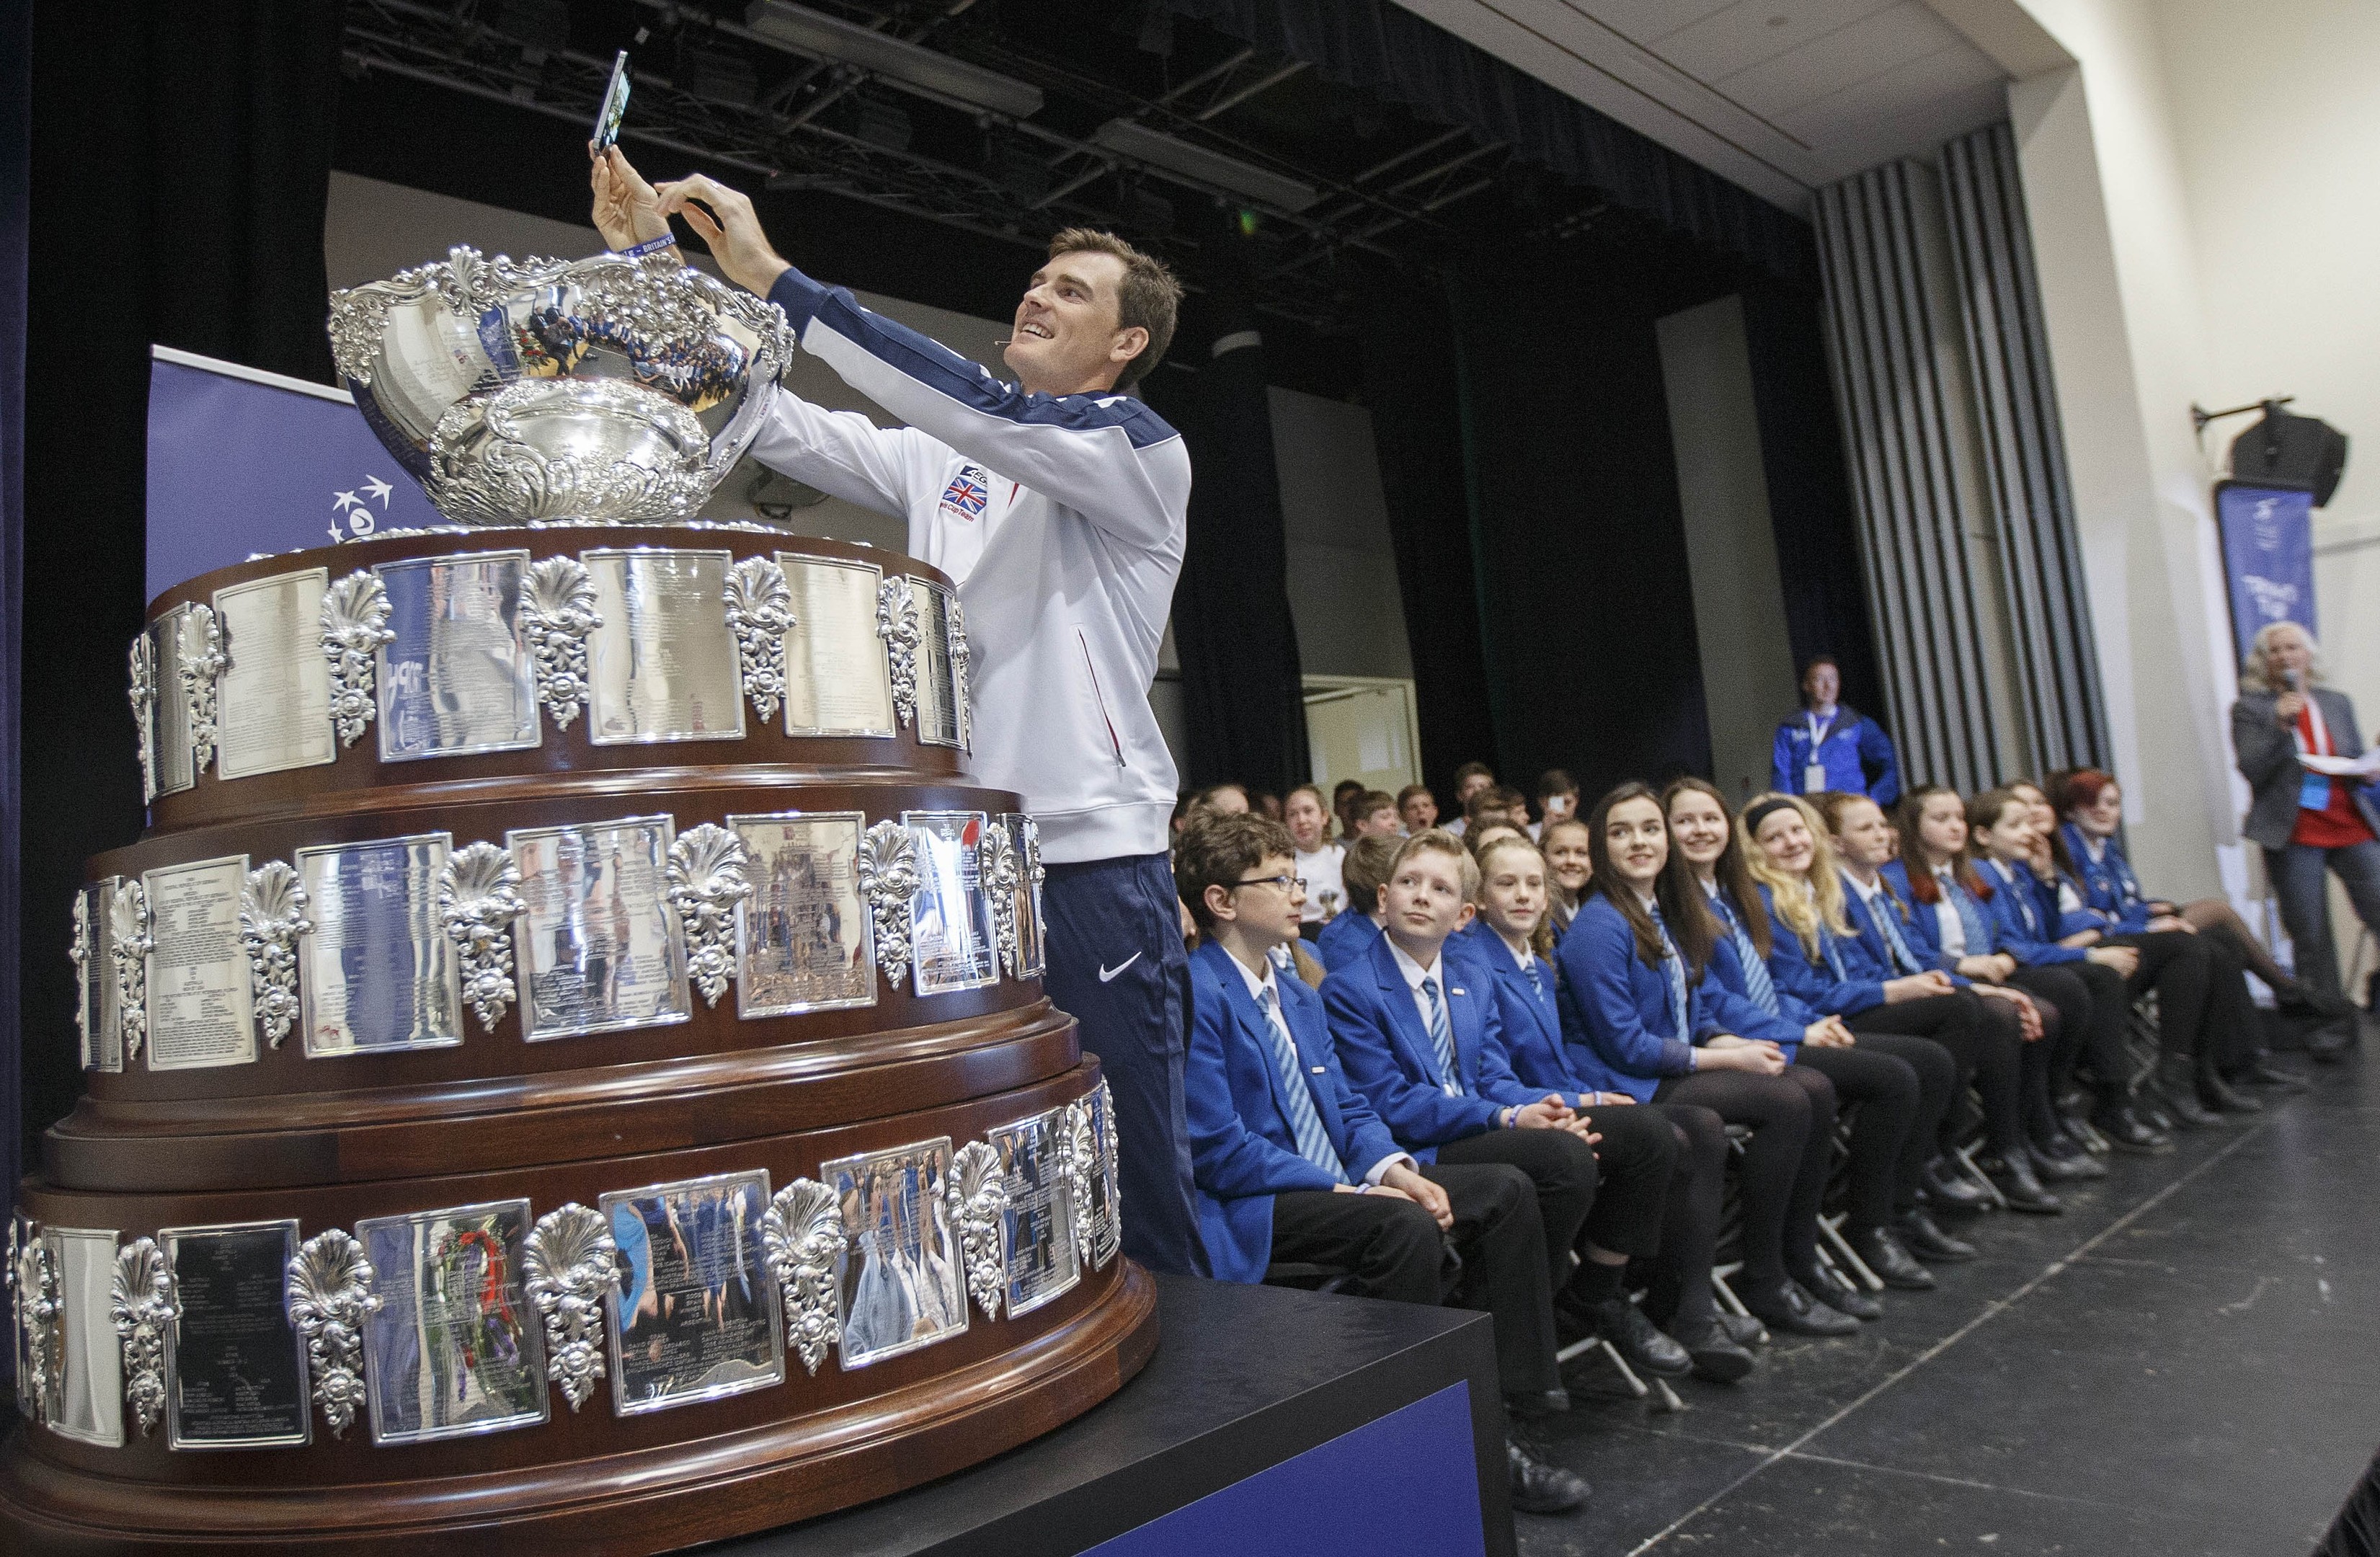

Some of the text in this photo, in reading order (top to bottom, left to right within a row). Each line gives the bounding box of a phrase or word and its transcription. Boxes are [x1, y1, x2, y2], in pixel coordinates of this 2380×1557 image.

[642, 236, 671, 253] BRITAIN'S
[947, 504, 959, 514] Cup
[959, 509, 974, 522] Team
